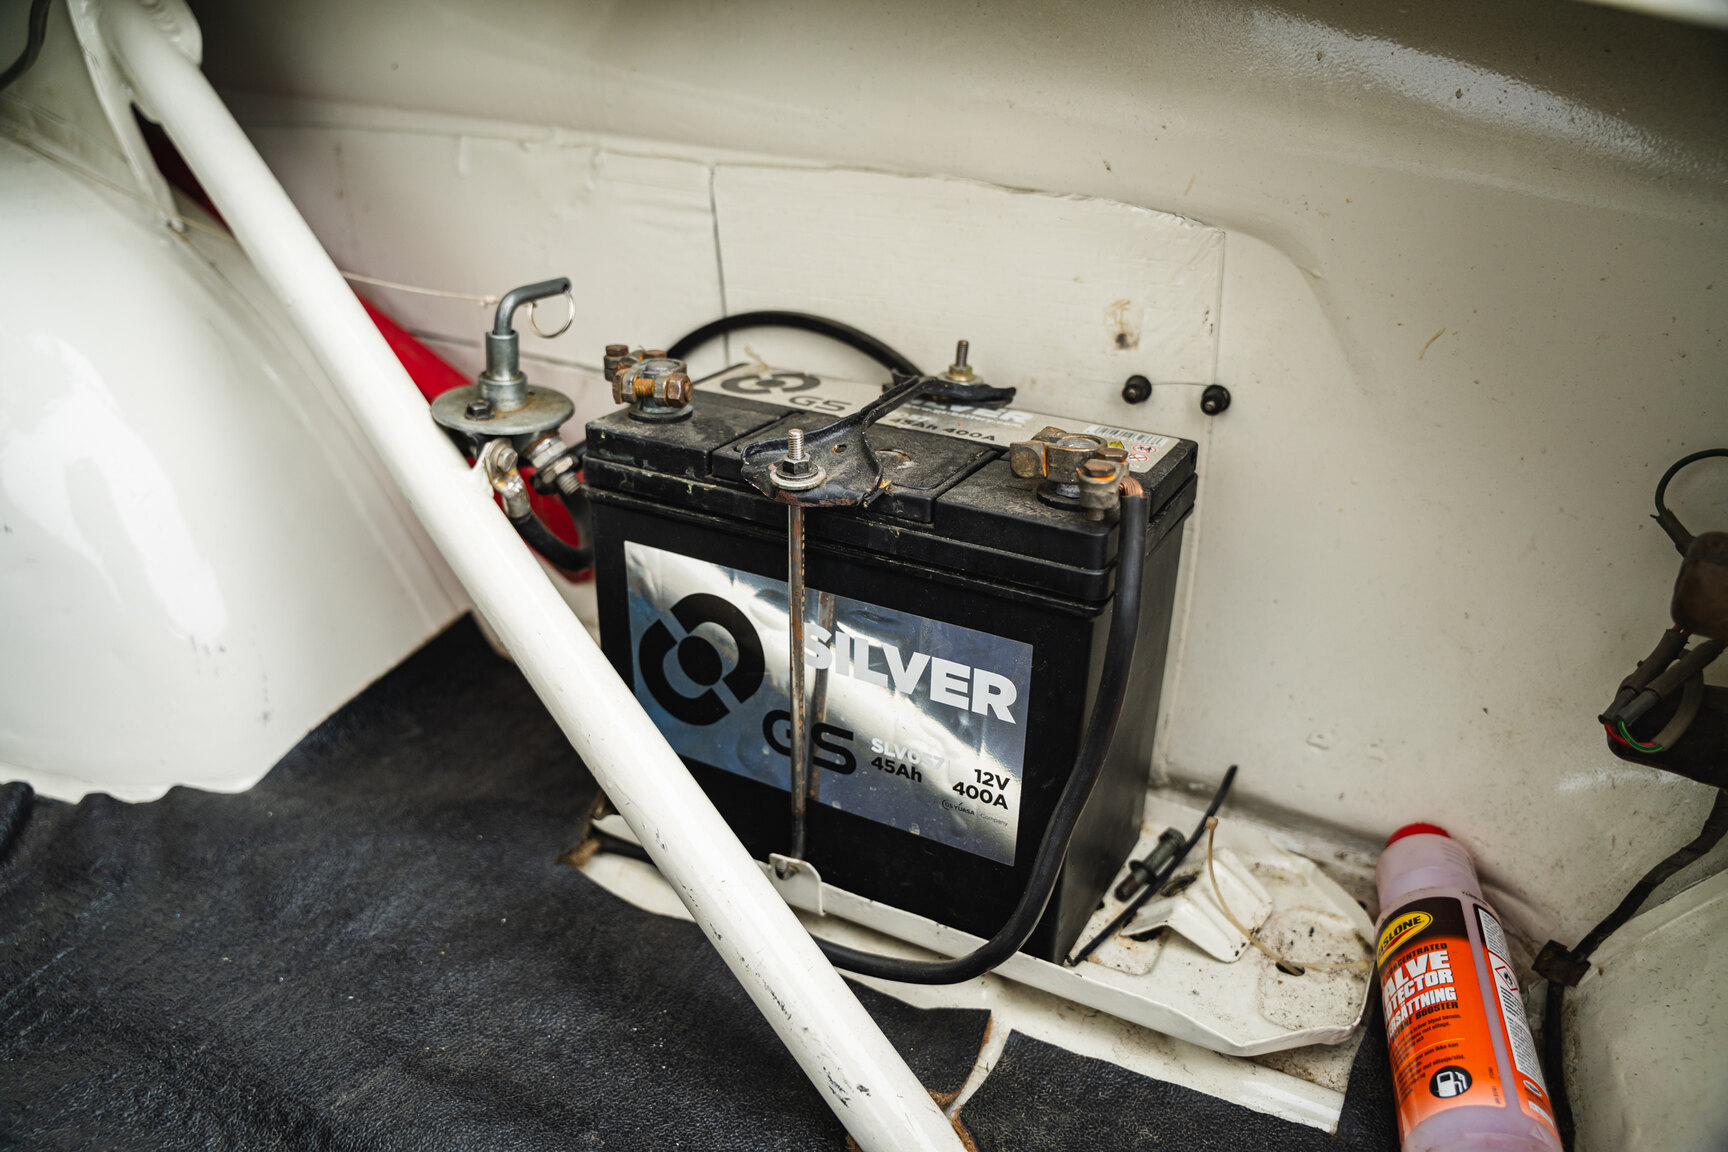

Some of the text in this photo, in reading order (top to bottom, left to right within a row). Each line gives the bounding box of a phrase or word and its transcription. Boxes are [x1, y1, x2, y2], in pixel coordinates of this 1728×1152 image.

[788, 395, 852, 412] GS
[943, 427, 996, 442] 400A
[804, 622, 1018, 725] SILVER
[762, 708, 857, 776] GS
[870, 737, 946, 771] SLV057
[870, 756, 923, 783] 45Ah
[974, 768, 1011, 791] 12V
[952, 781, 1009, 810] 400A
[953, 802, 976, 817] YUASA
[980, 812, 1009, 828] Company
[1383, 950, 1451, 1006] ALVE
[1385, 968, 1455, 1022] OTECTOR
[1415, 1001, 1459, 1020] BOOSTER
